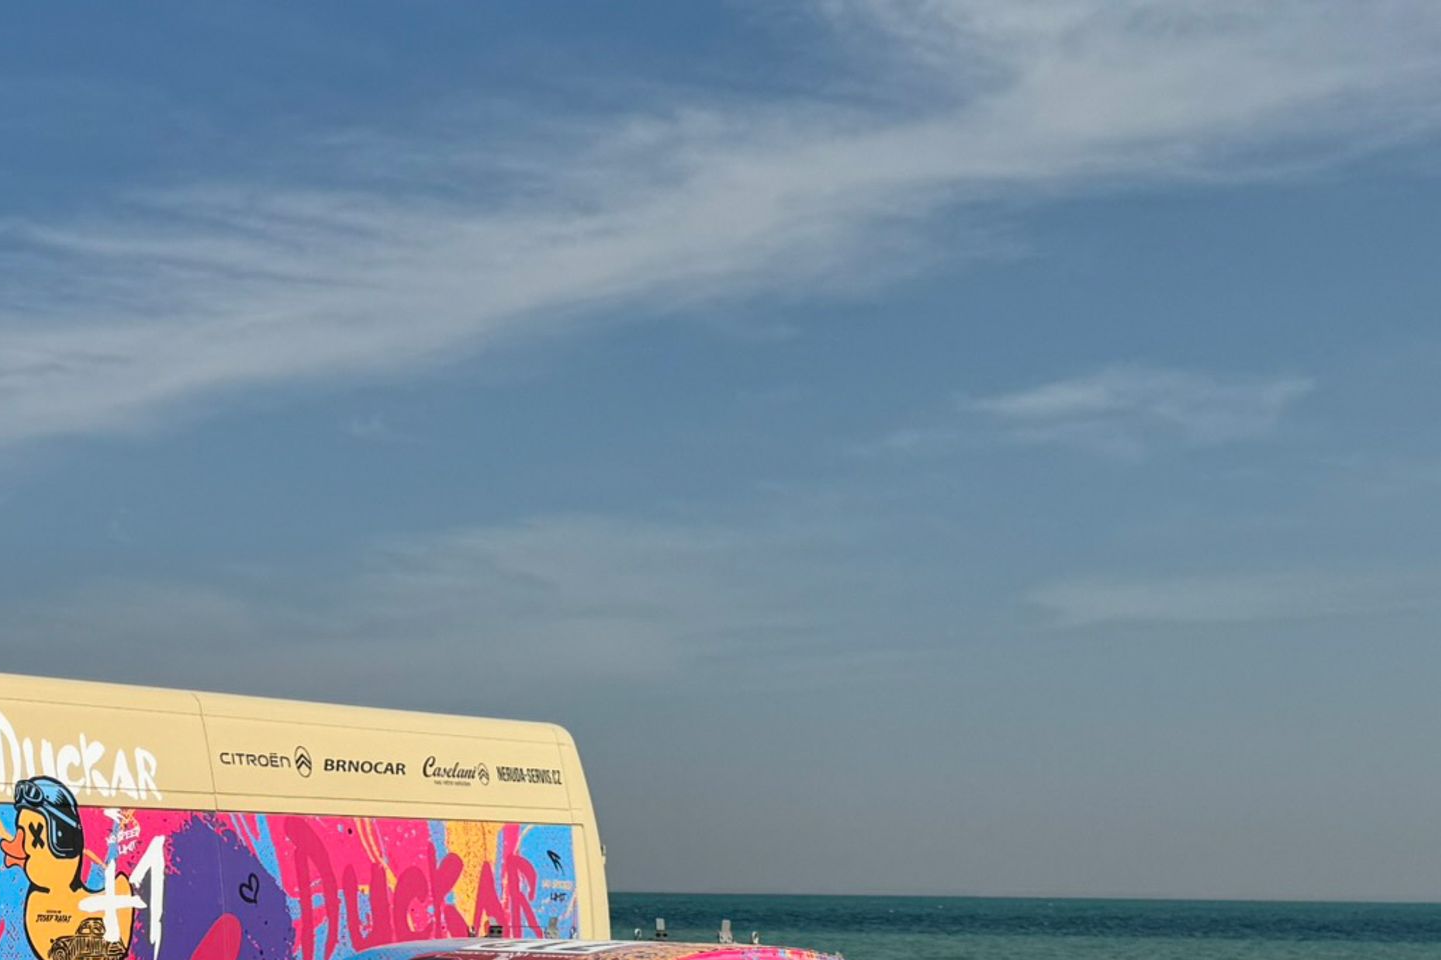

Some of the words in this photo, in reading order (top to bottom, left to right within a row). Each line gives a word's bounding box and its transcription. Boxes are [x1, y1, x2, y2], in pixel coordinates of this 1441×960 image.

[220, 752, 291, 768] CITROËN
[323, 759, 406, 775] BRNOCAR
[422, 755, 476, 779] Caselani
[496, 766, 562, 785] NERUDA-SERVIS.CZ
